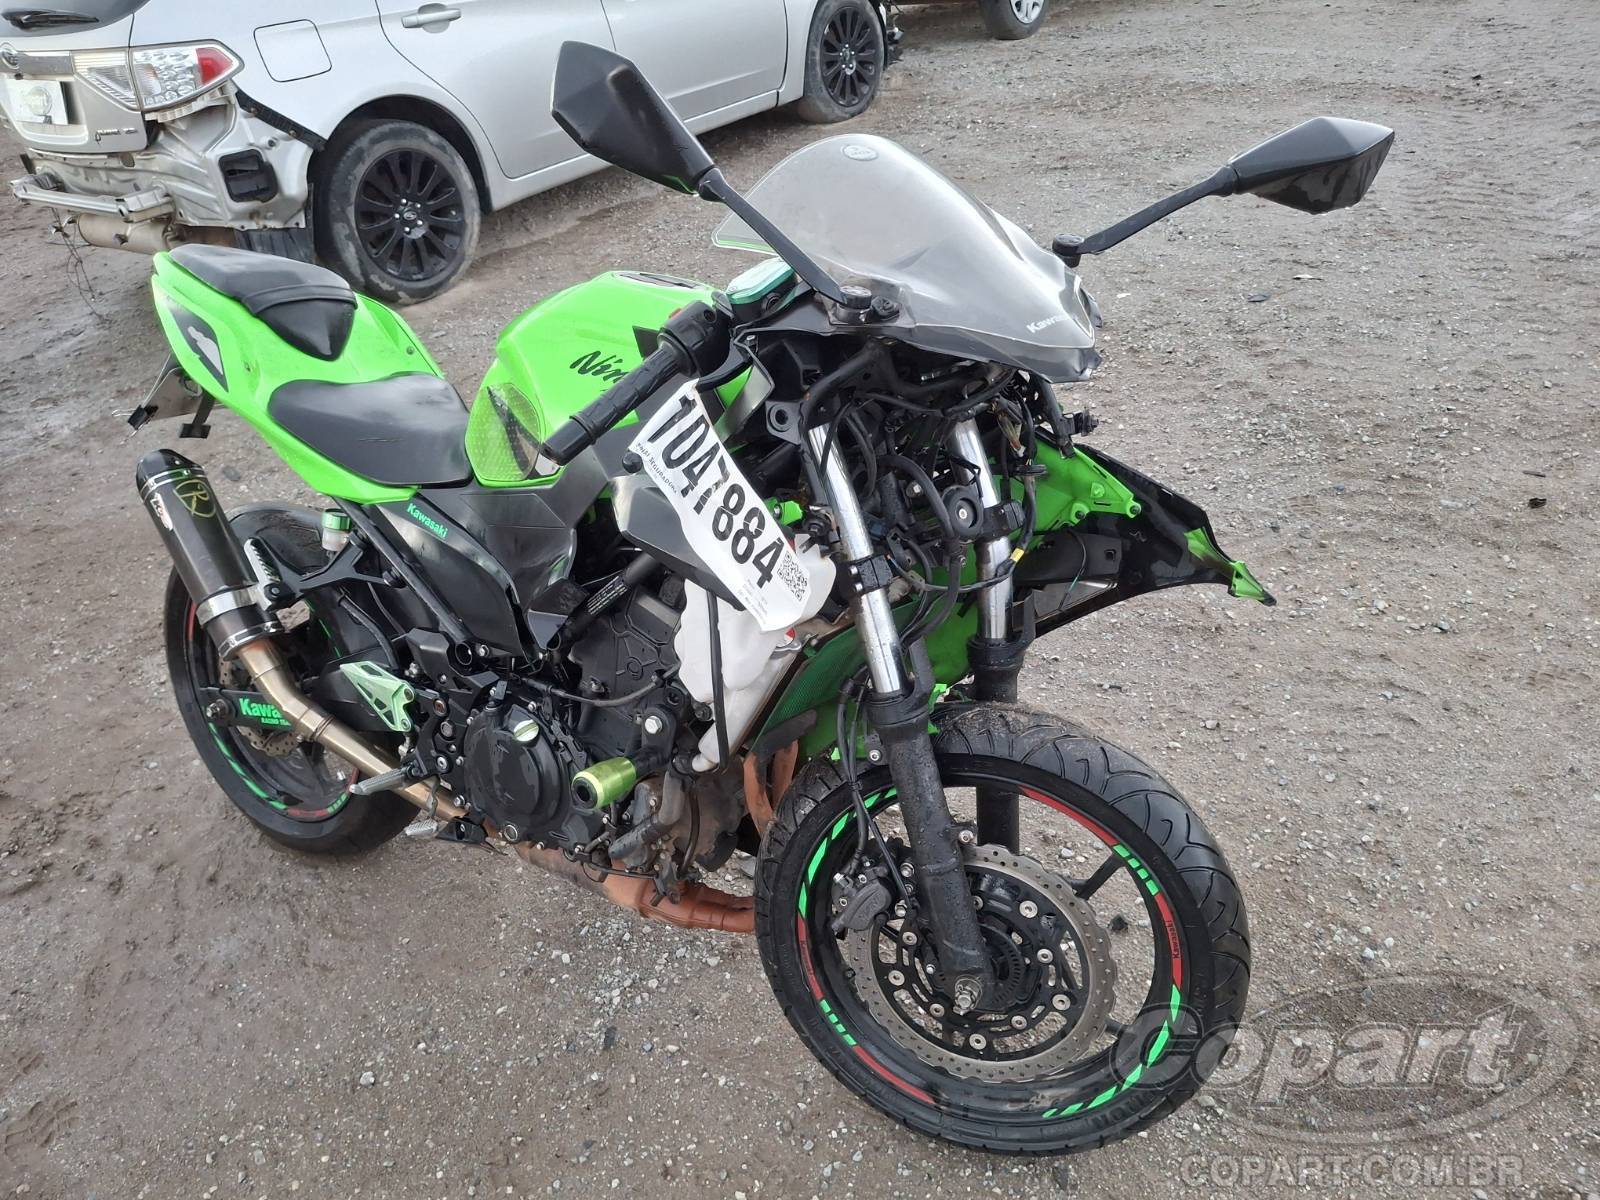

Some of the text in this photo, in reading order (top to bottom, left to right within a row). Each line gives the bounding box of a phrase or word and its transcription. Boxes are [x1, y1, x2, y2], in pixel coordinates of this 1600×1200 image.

[569, 350, 630, 384] Nin
[647, 396, 785, 588] 1047884
[407, 502, 449, 538] Kawasaki
[239, 697, 283, 718] Kawa
